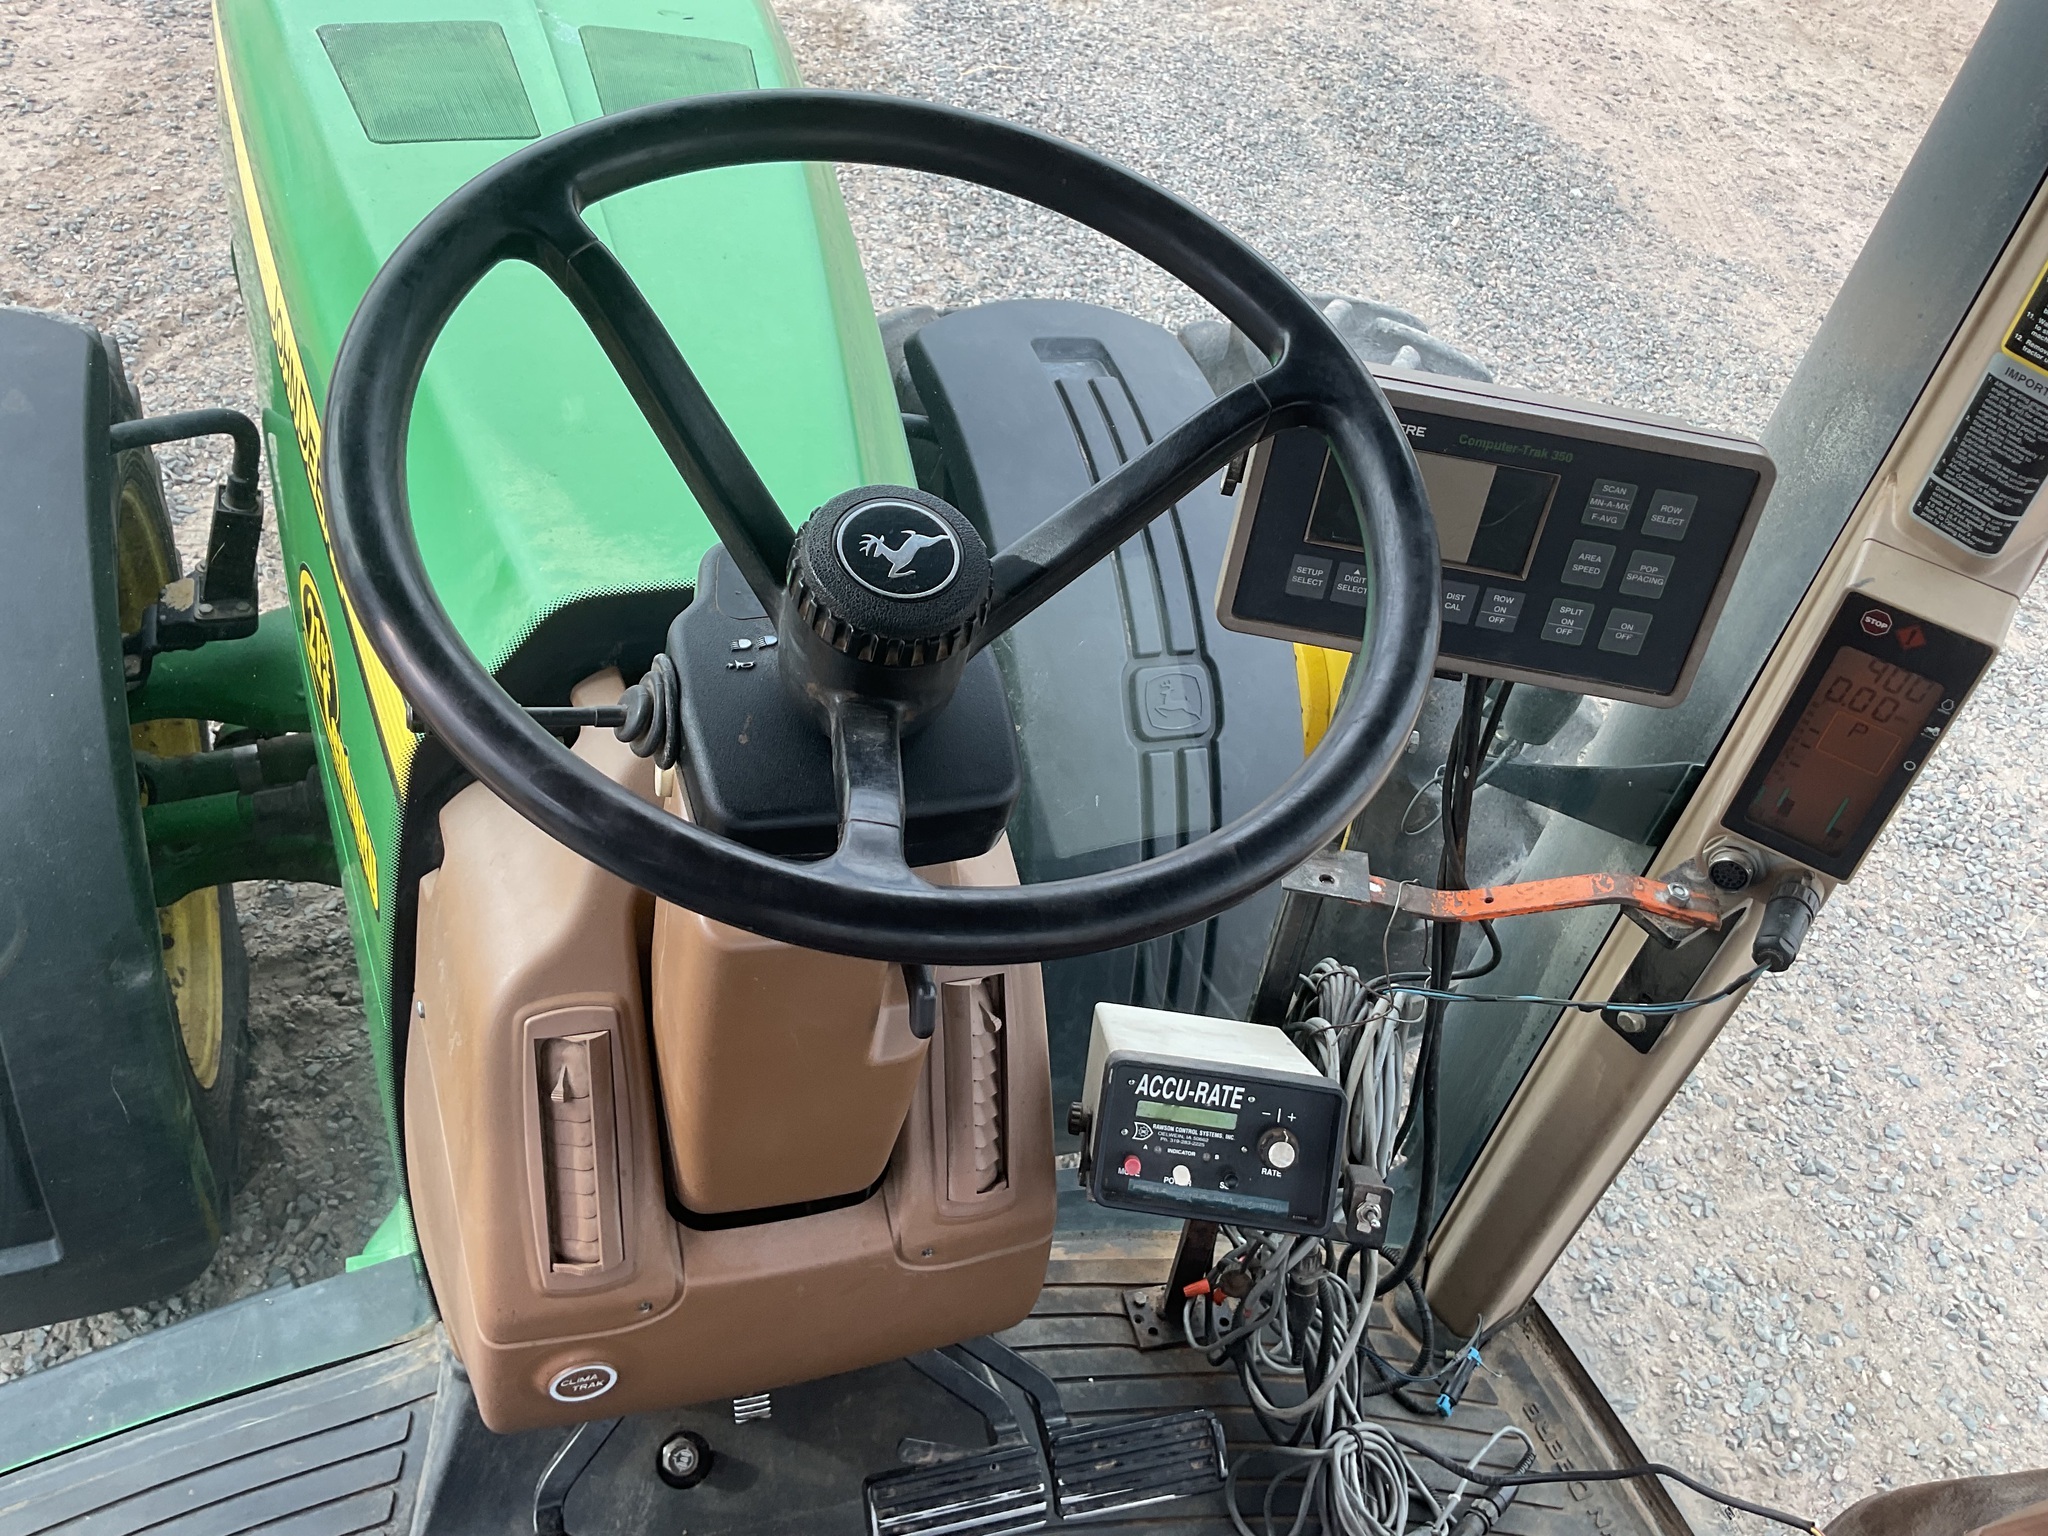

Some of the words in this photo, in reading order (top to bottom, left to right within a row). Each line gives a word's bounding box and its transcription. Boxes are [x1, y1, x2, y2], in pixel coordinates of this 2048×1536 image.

[2014, 334, 2023, 342] 12.
[1458, 433, 1549, 460] Computer-Trak
[1551, 450, 1574, 463] 350
[1602, 484, 1628, 495] SCAN
[1589, 497, 1630, 511] MN-A-MX
[1660, 504, 1683, 515] ROW
[1591, 512, 1618, 524] F-AVG
[1650, 514, 1685, 526] SELECT
[1578, 552, 1602, 563] AREA
[1295, 565, 1324, 577] SETUP
[1572, 564, 1601, 575] SPEED
[1639, 564, 1659, 574] POP
[1291, 575, 1324, 587] SELECT
[1344, 574, 1367, 584] DIGIT
[1626, 573, 1665, 586] SPACING
[1446, 592, 1467, 602] DIST
[1493, 594, 1515, 604] ROW
[1444, 602, 1461, 612] CAL
[1493, 605, 1507, 614] ON
[1559, 606, 1584, 616] SPLIT
[1488, 615, 1506, 624] OFF
[1560, 618, 1575, 627] ON
[1864, 615, 1889, 630] STOP
[1555, 627, 1573, 636] OFF
[1620, 622, 1634, 631] ON
[1615, 632, 1634, 641] OFF
[1825, 675, 1900, 724] 0.00
[1846, 722, 1869, 738] P
[1134, 1073, 1246, 1110] ACCU-RATE
[1175, 1126, 1198, 1134] CONTROL
[1261, 1167, 1282, 1178] RATE
[560, 1373, 598, 1387] CLIMA
[572, 1380, 604, 1392] TRAK
